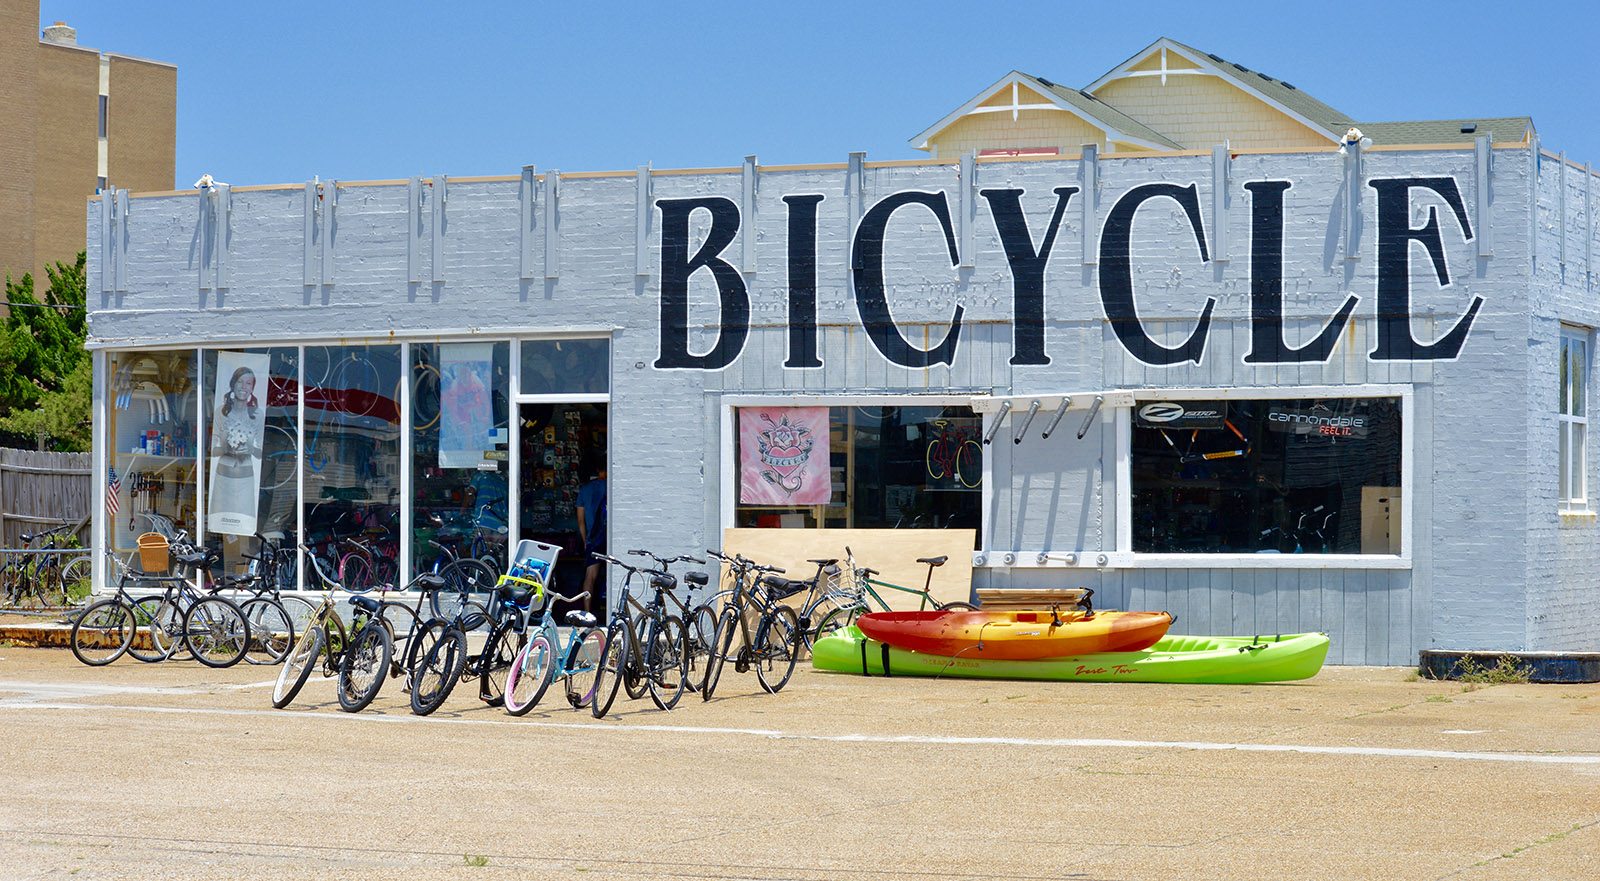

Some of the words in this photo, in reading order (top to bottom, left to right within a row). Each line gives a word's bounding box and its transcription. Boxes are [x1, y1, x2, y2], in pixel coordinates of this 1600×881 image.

[652, 174, 1485, 371] BICYCLE
[1268, 412, 1364, 427] cannondale
[1319, 425, 1341, 436] FEEL
